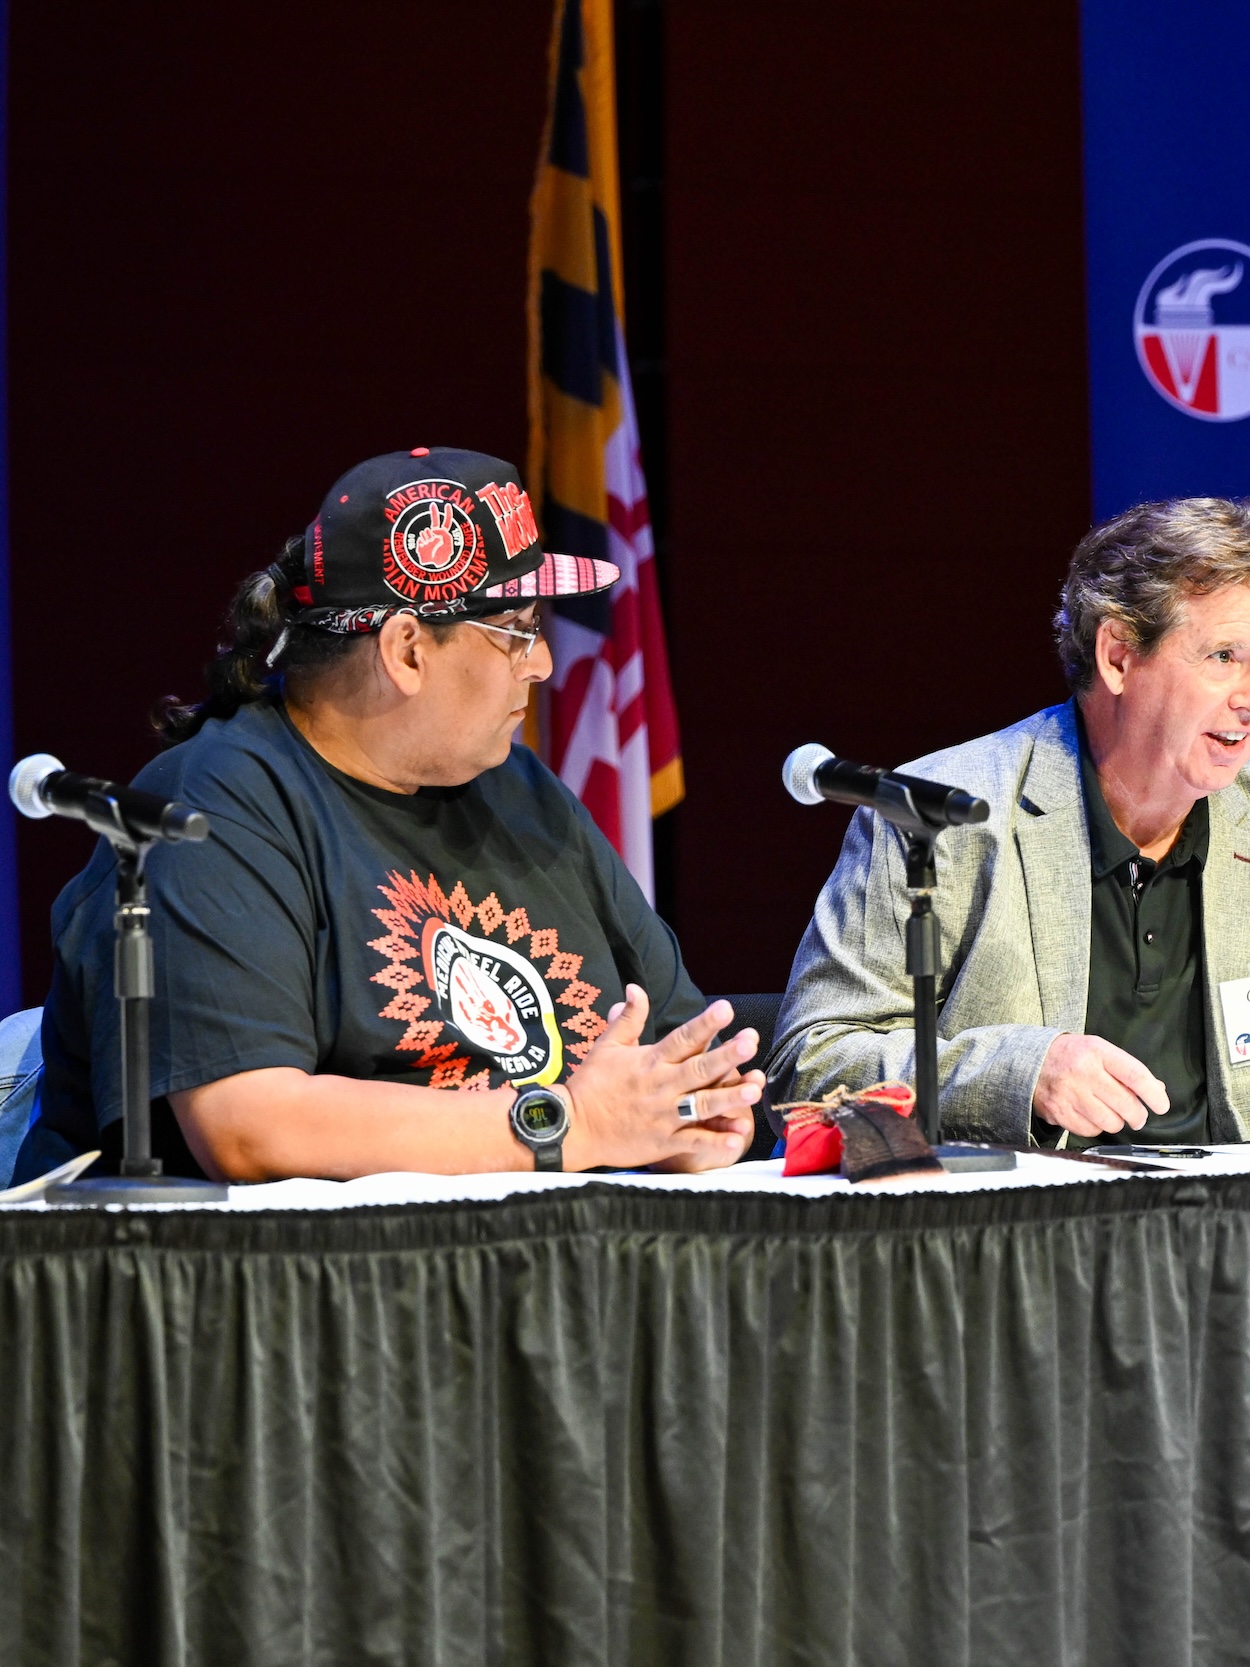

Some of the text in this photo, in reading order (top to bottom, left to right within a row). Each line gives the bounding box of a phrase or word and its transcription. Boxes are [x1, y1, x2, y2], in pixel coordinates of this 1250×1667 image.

[384, 483, 475, 524] AMERICAN
[383, 524, 488, 601] INDIAN MOVEMENT
[394, 521, 473, 582] REMEMBER WOUNDED KNEE
[503, 975, 539, 1020] RIDE
